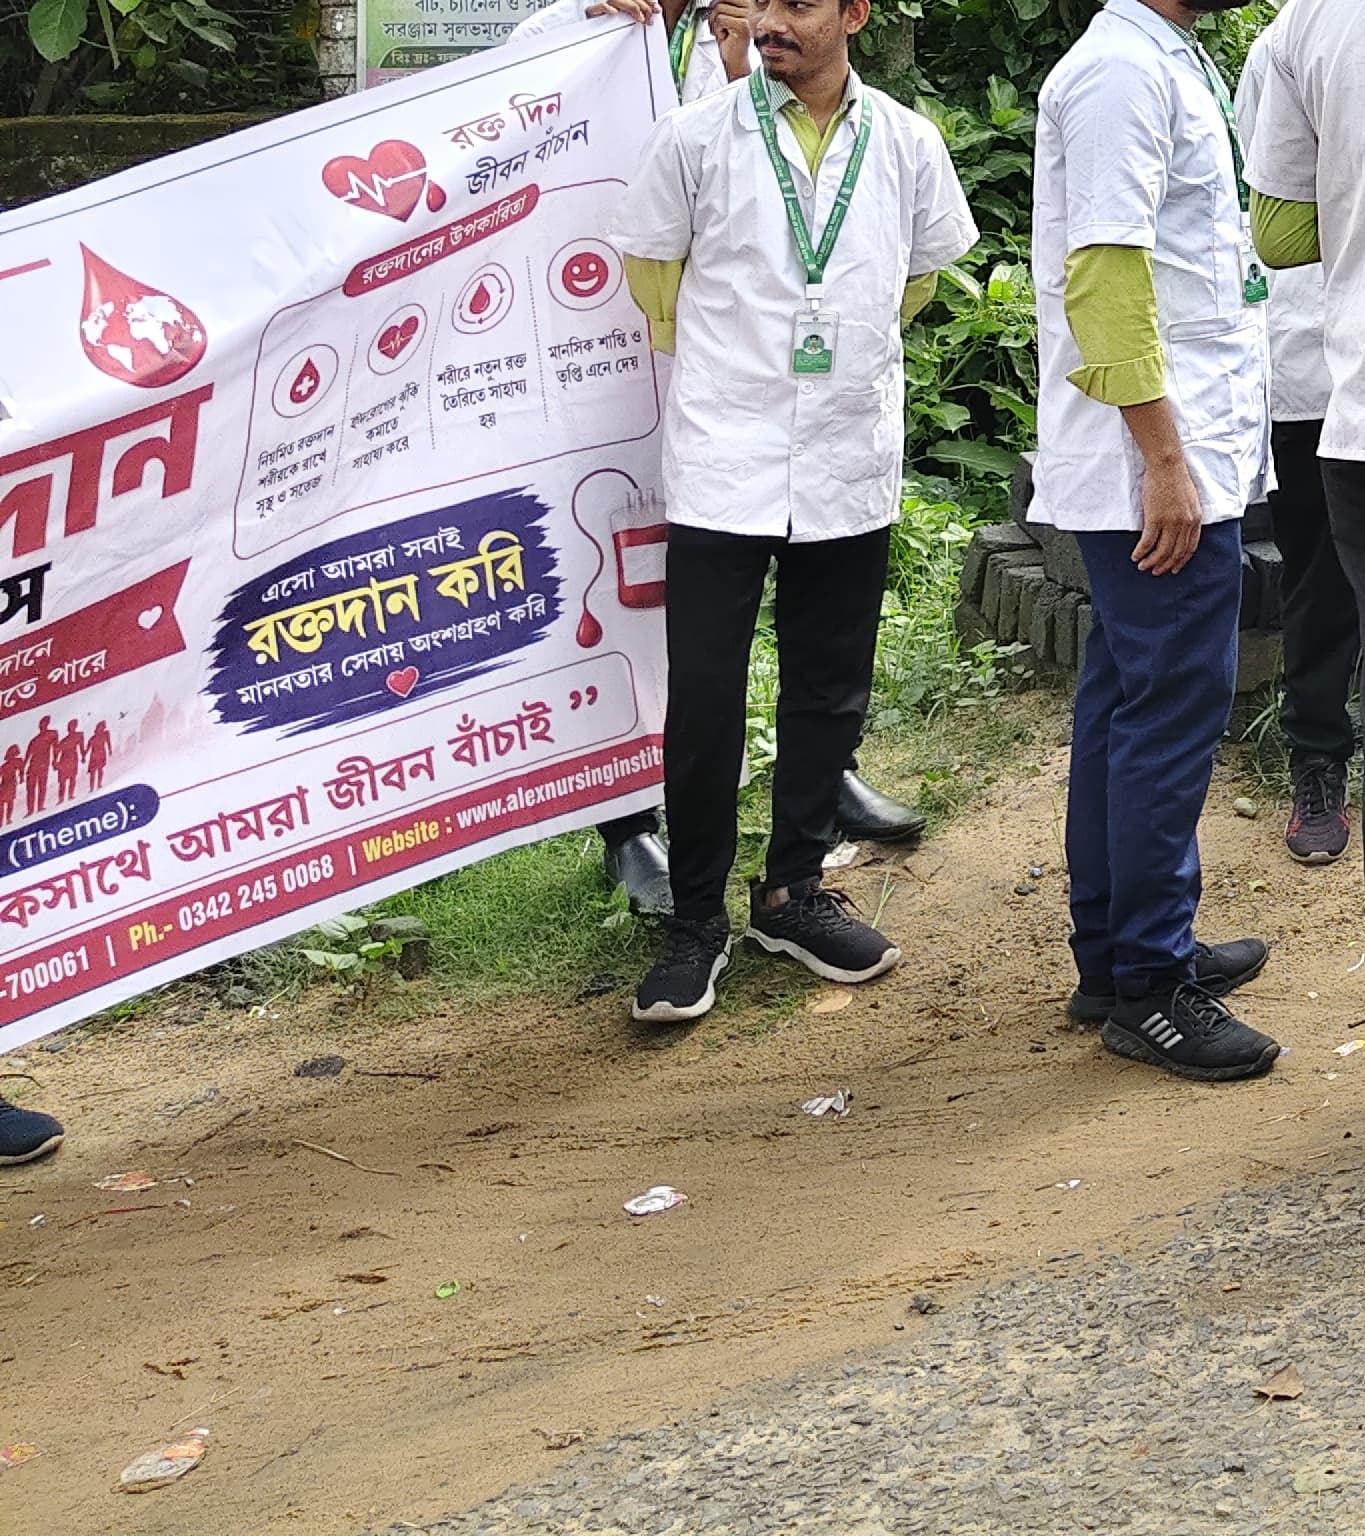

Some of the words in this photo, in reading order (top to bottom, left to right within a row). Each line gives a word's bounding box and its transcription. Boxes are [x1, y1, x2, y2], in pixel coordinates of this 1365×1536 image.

[441, 112, 505, 149] রক্ত
[508, 92, 562, 131] দিন
[465, 156, 529, 195] জীবন
[535, 120, 590, 162] বাঁচান
[361, 235, 446, 284] রক্তদানের
[449, 194, 527, 245] উপকারিতা
[548, 336, 595, 360] মানসিক
[597, 328, 628, 351] শান্তি
[631, 330, 642, 343] ও
[436, 364, 470, 386] শরীরে
[474, 359, 502, 381] নতুন
[505, 352, 527, 370] রক্ত
[556, 363, 584, 390] তৃপ্তি
[585, 360, 612, 377] এনে
[616, 355, 640, 373] দেয়
[440, 387, 486, 412] তৈরিতে
[365, 416, 399, 442] কমাতে
[479, 412, 497, 429] হয়
[257, 442, 295, 470] নিয়মিত
[385, 435, 410, 454] করে
[277, 491, 286, 502] ও
[261, 568, 316, 603] এসো
[320, 545, 395, 580] আমরা
[403, 526, 465, 560] সবাই
[243, 575, 420, 666] রক্তদান
[427, 531, 525, 608] করি
[48, 649, 107, 686] পারে
[236, 663, 333, 705] মানবতার
[341, 640, 405, 677] সেবায়
[408, 610, 502, 654] অংশগ্রহণ
[505, 593, 547, 624] করি
[166, 786, 309, 862] আমরা
[323, 755, 434, 810] জীবন
[448, 701, 555, 767] বাঁচাই
[8, 800, 138, 868] (Theme):
[179, 892, 233, 931] 0342
[238, 875, 277, 908] 245
[283, 854, 335, 893] 0068
[362, 819, 440, 863] Website
